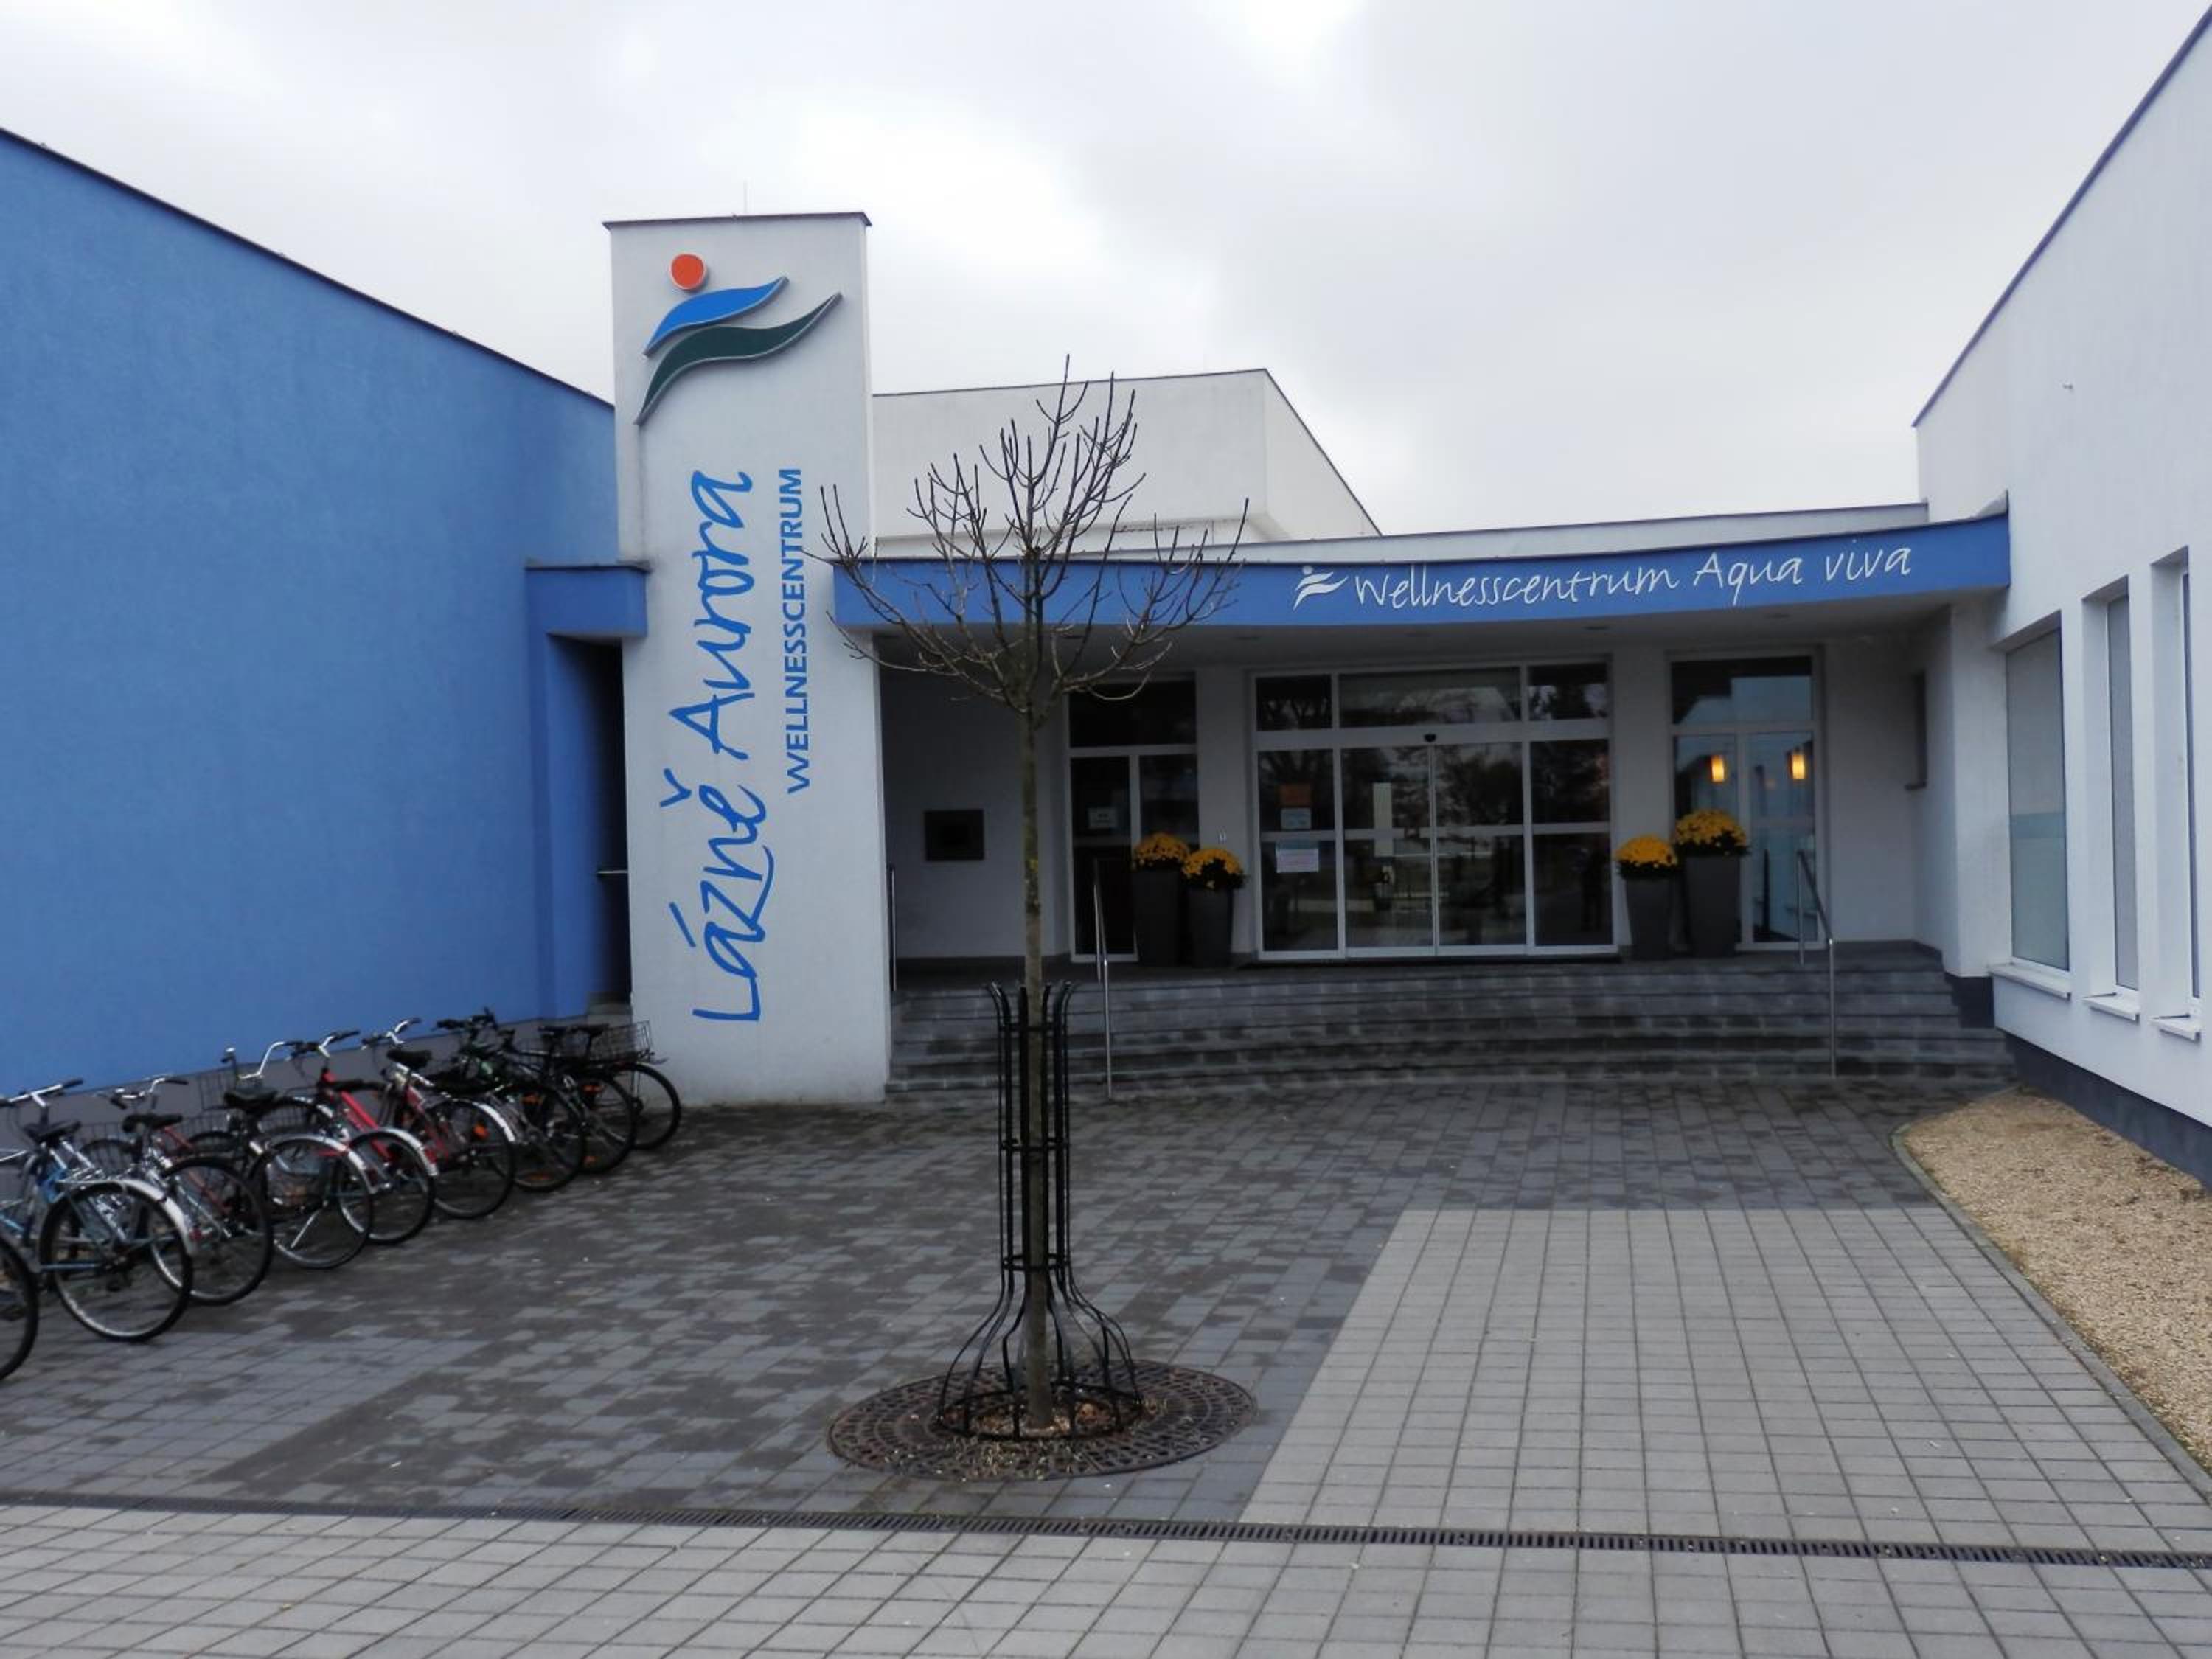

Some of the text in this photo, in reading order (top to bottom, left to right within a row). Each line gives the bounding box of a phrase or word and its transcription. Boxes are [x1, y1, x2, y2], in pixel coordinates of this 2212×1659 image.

[779, 467, 810, 794] WELLNESSCENTRUM
[1354, 539, 1912, 609] Wellnesscentrum Aqua viva
[659, 470, 775, 1023] Lázně Aurora
